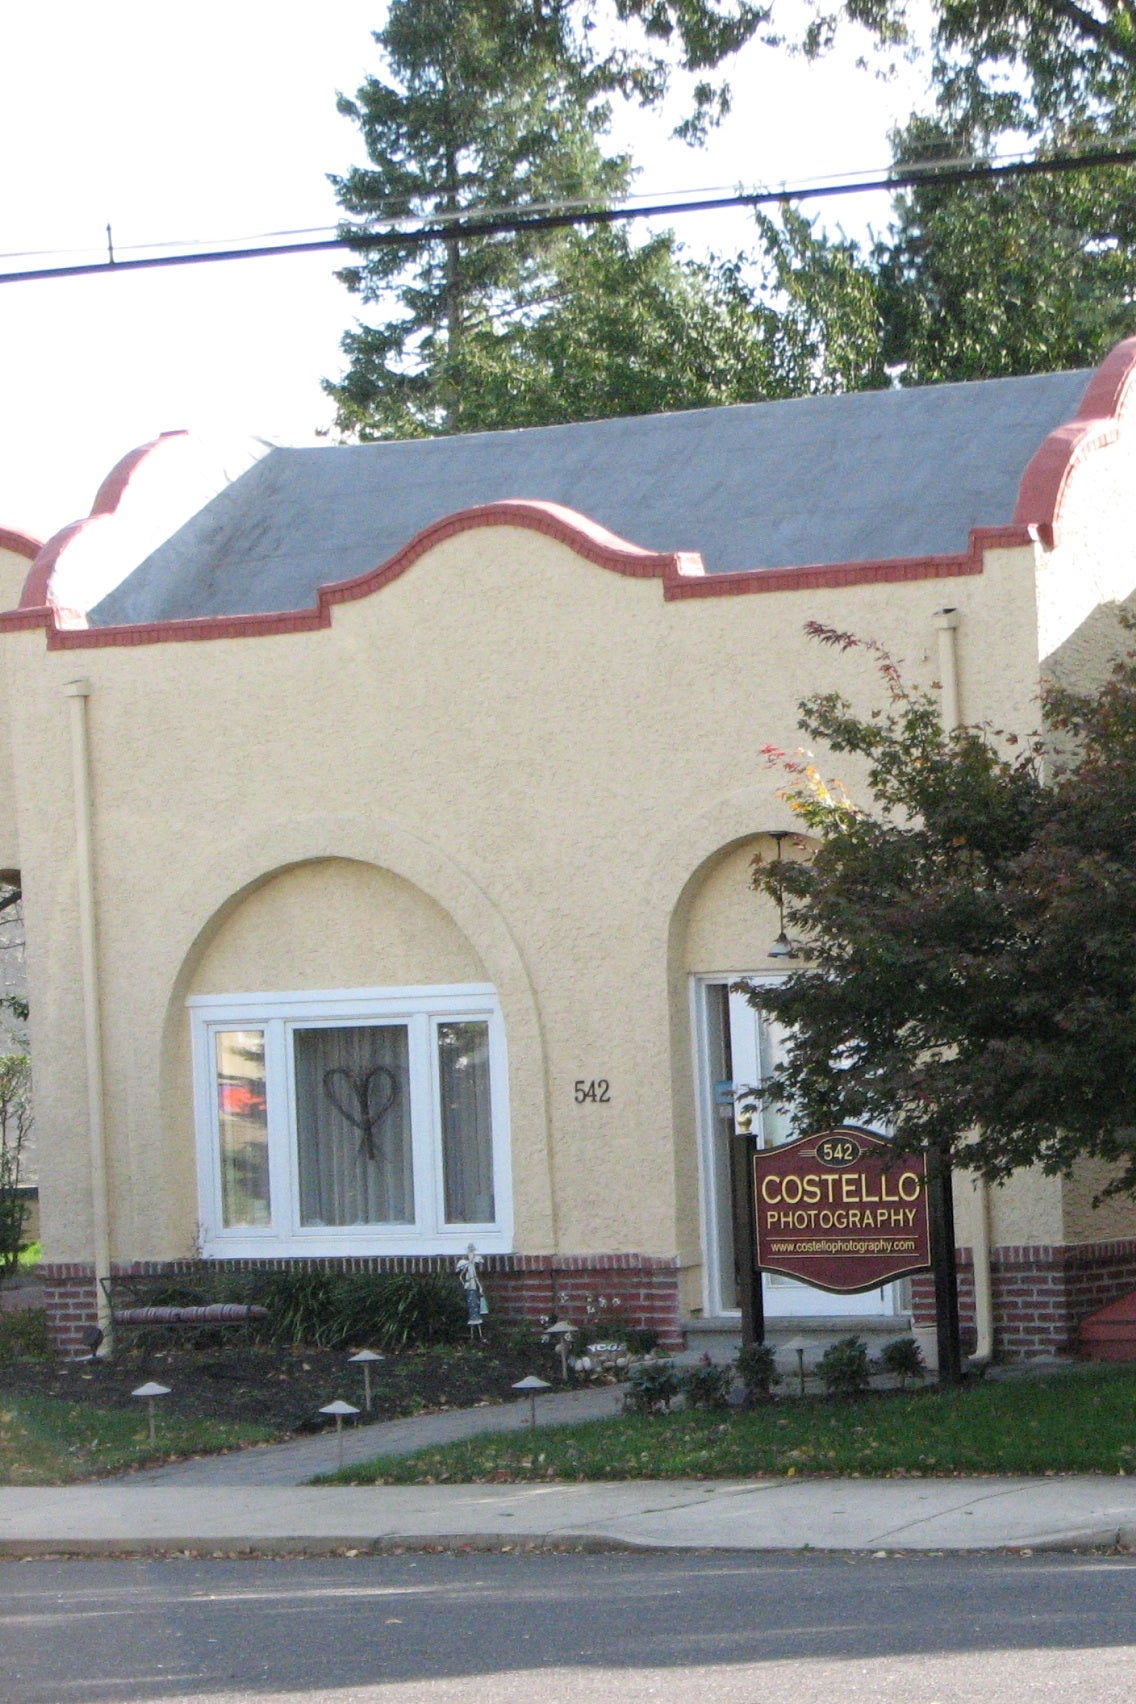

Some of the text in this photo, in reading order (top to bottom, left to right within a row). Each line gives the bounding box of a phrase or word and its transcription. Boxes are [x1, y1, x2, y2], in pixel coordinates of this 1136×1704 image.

[575, 1080, 611, 1103] 542
[823, 1143, 853, 1160] 542
[762, 1172, 920, 1204] COSTELLO
[767, 1209, 917, 1229] PHOTOGRAPHY
[771, 1240, 915, 1254] www.costellophotography.com
